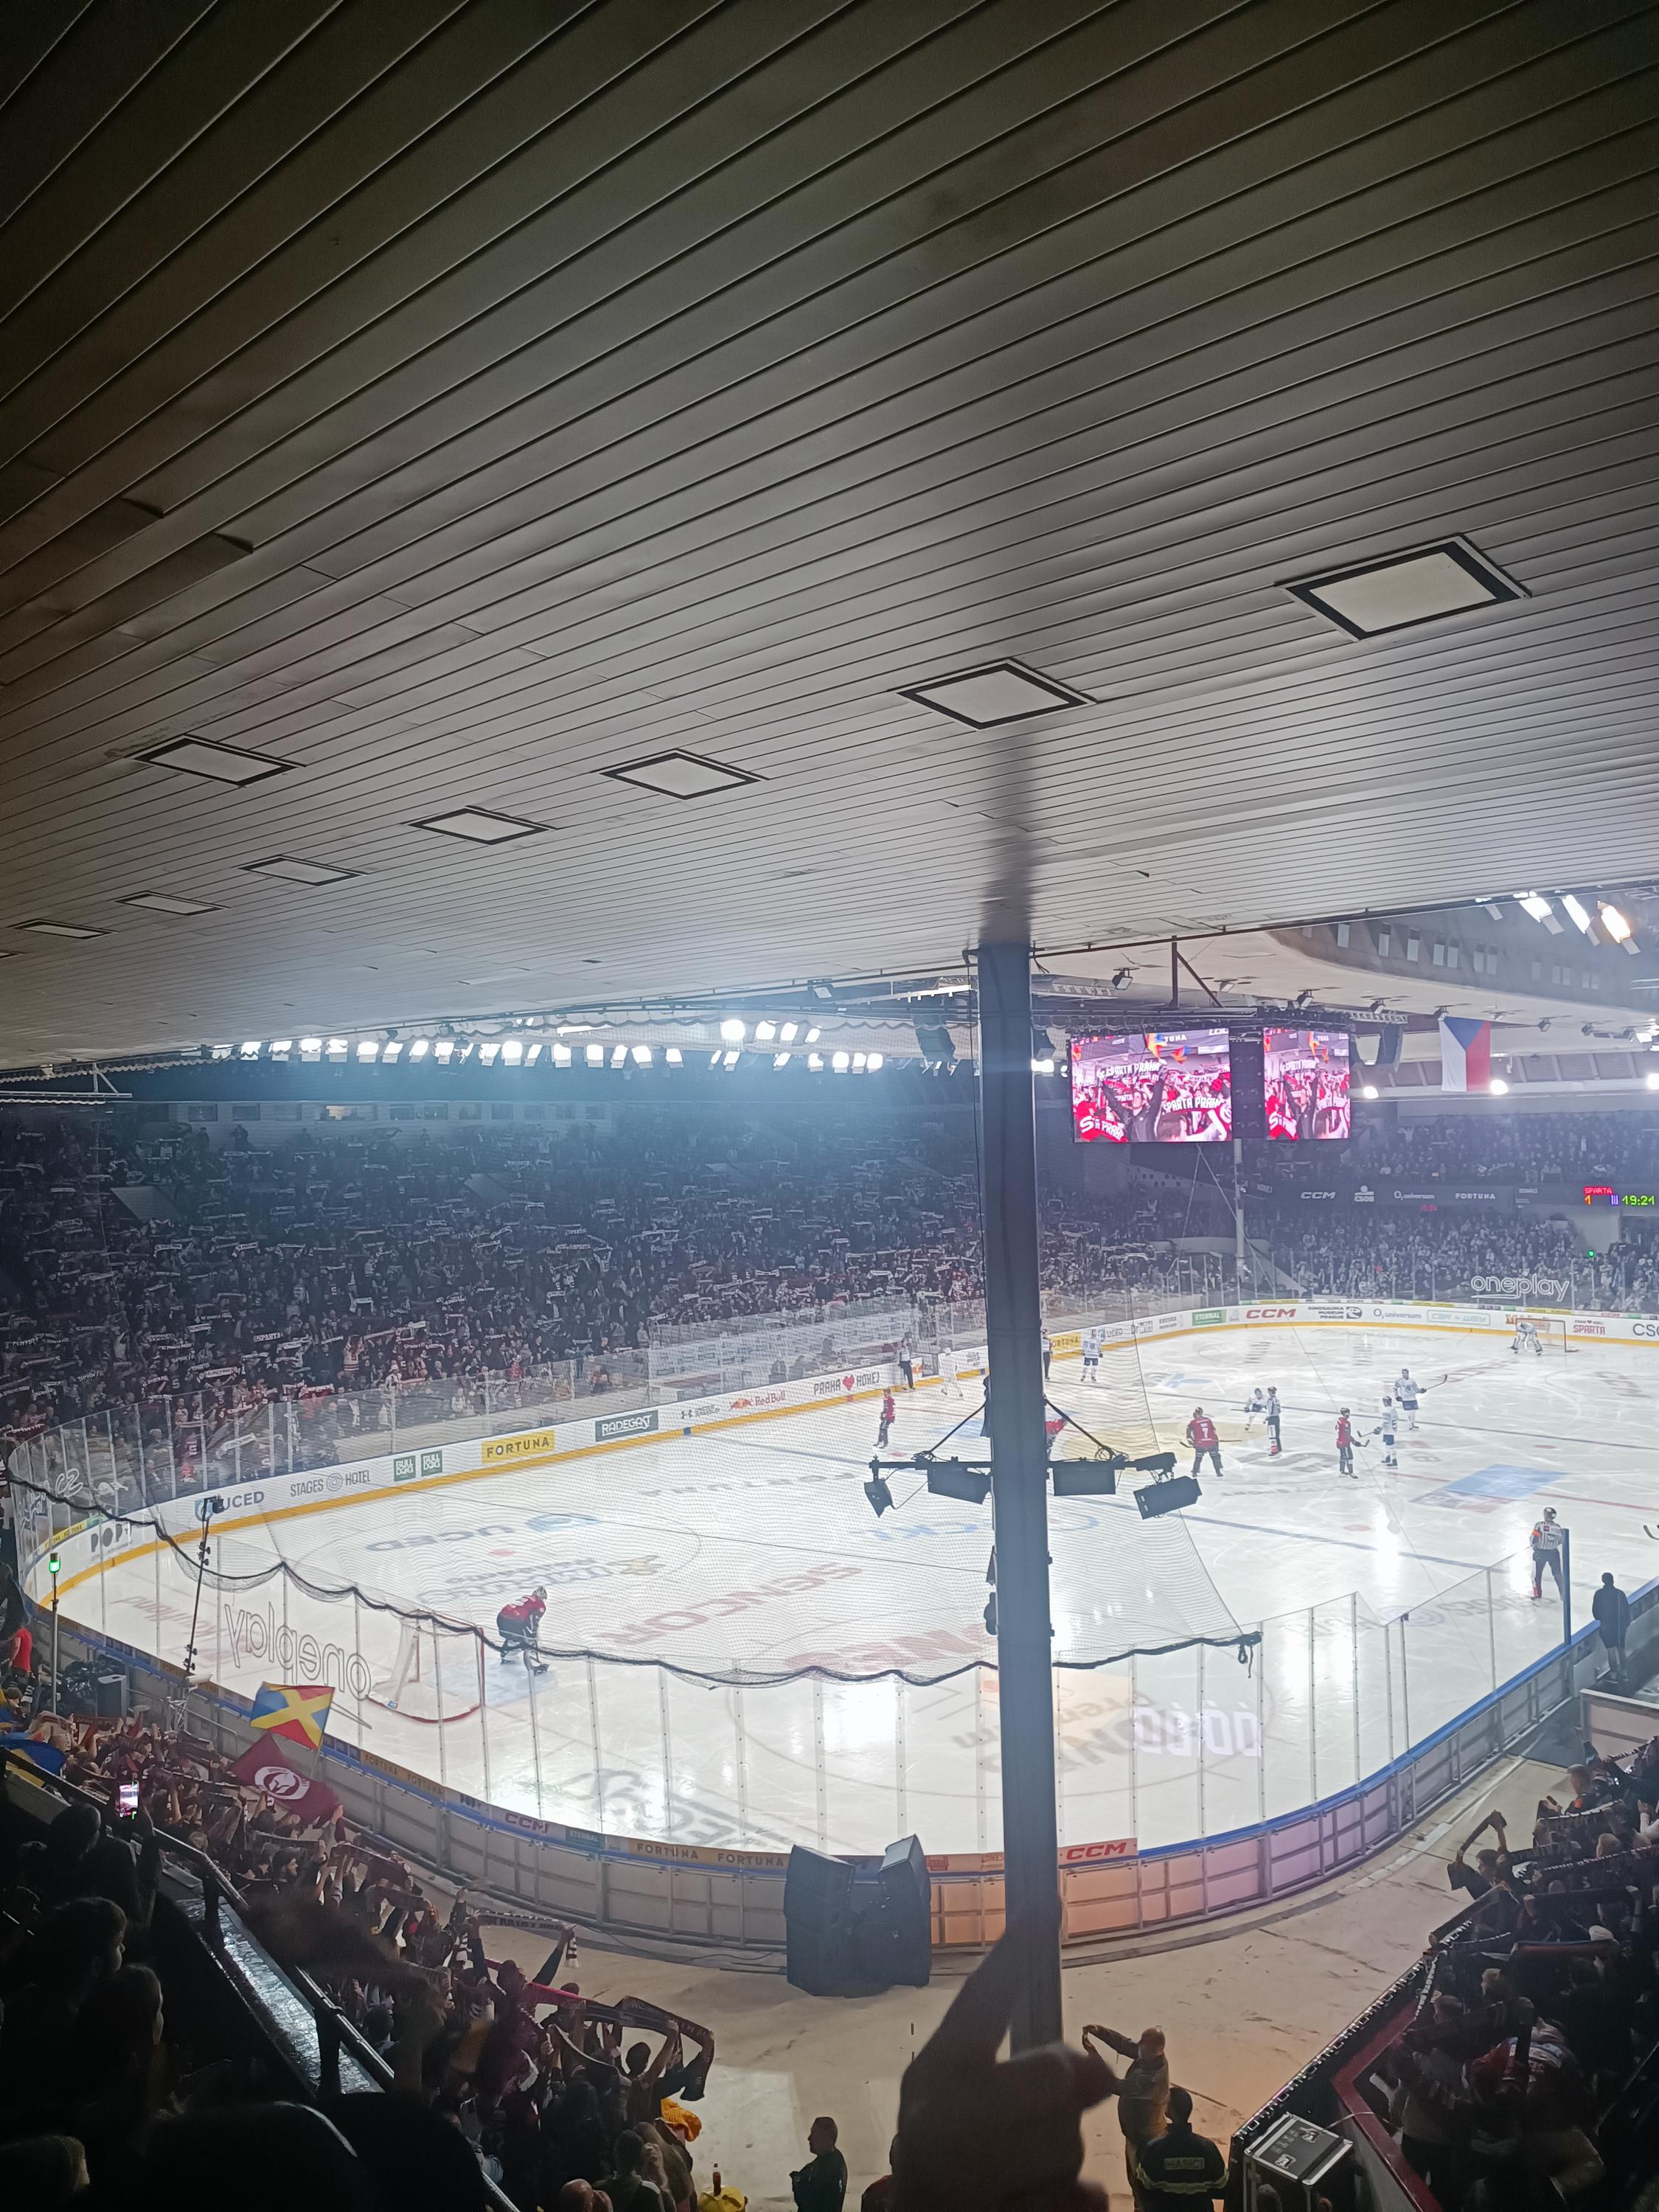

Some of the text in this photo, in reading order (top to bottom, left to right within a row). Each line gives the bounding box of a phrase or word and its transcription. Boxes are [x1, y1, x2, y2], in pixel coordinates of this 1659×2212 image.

[1301, 1192, 1336, 1200] CCM
[1471, 1273, 1570, 1302] oneplay
[1246, 1308, 1296, 1319] CCM
[1573, 1324, 1606, 1335] SPARTA
[1052, 1336, 1079, 1348] ORTUNA
[814, 1371, 880, 1395] PRAHA HOKEJ
[755, 1391, 786, 1406] Red Bull
[602, 1415, 653, 1437] RADEGAST
[487, 1436, 549, 1458] FORTUNA
[395, 1458, 414, 1470] BULL
[423, 1454, 440, 1464] BULL
[423, 1461, 441, 1471] DOG
[395, 1467, 414, 1476] DOG
[290, 1470, 371, 1498] STAGES HOTEL
[365, 1756, 442, 1795] FORTUNA FORTUNA
[504, 1812, 550, 1834] CCM
[569, 1830, 599, 1843] ETERNAL
[637, 1843, 785, 1867] FORTUNA FORTUNA
[1066, 1842, 1128, 1860] CCM
